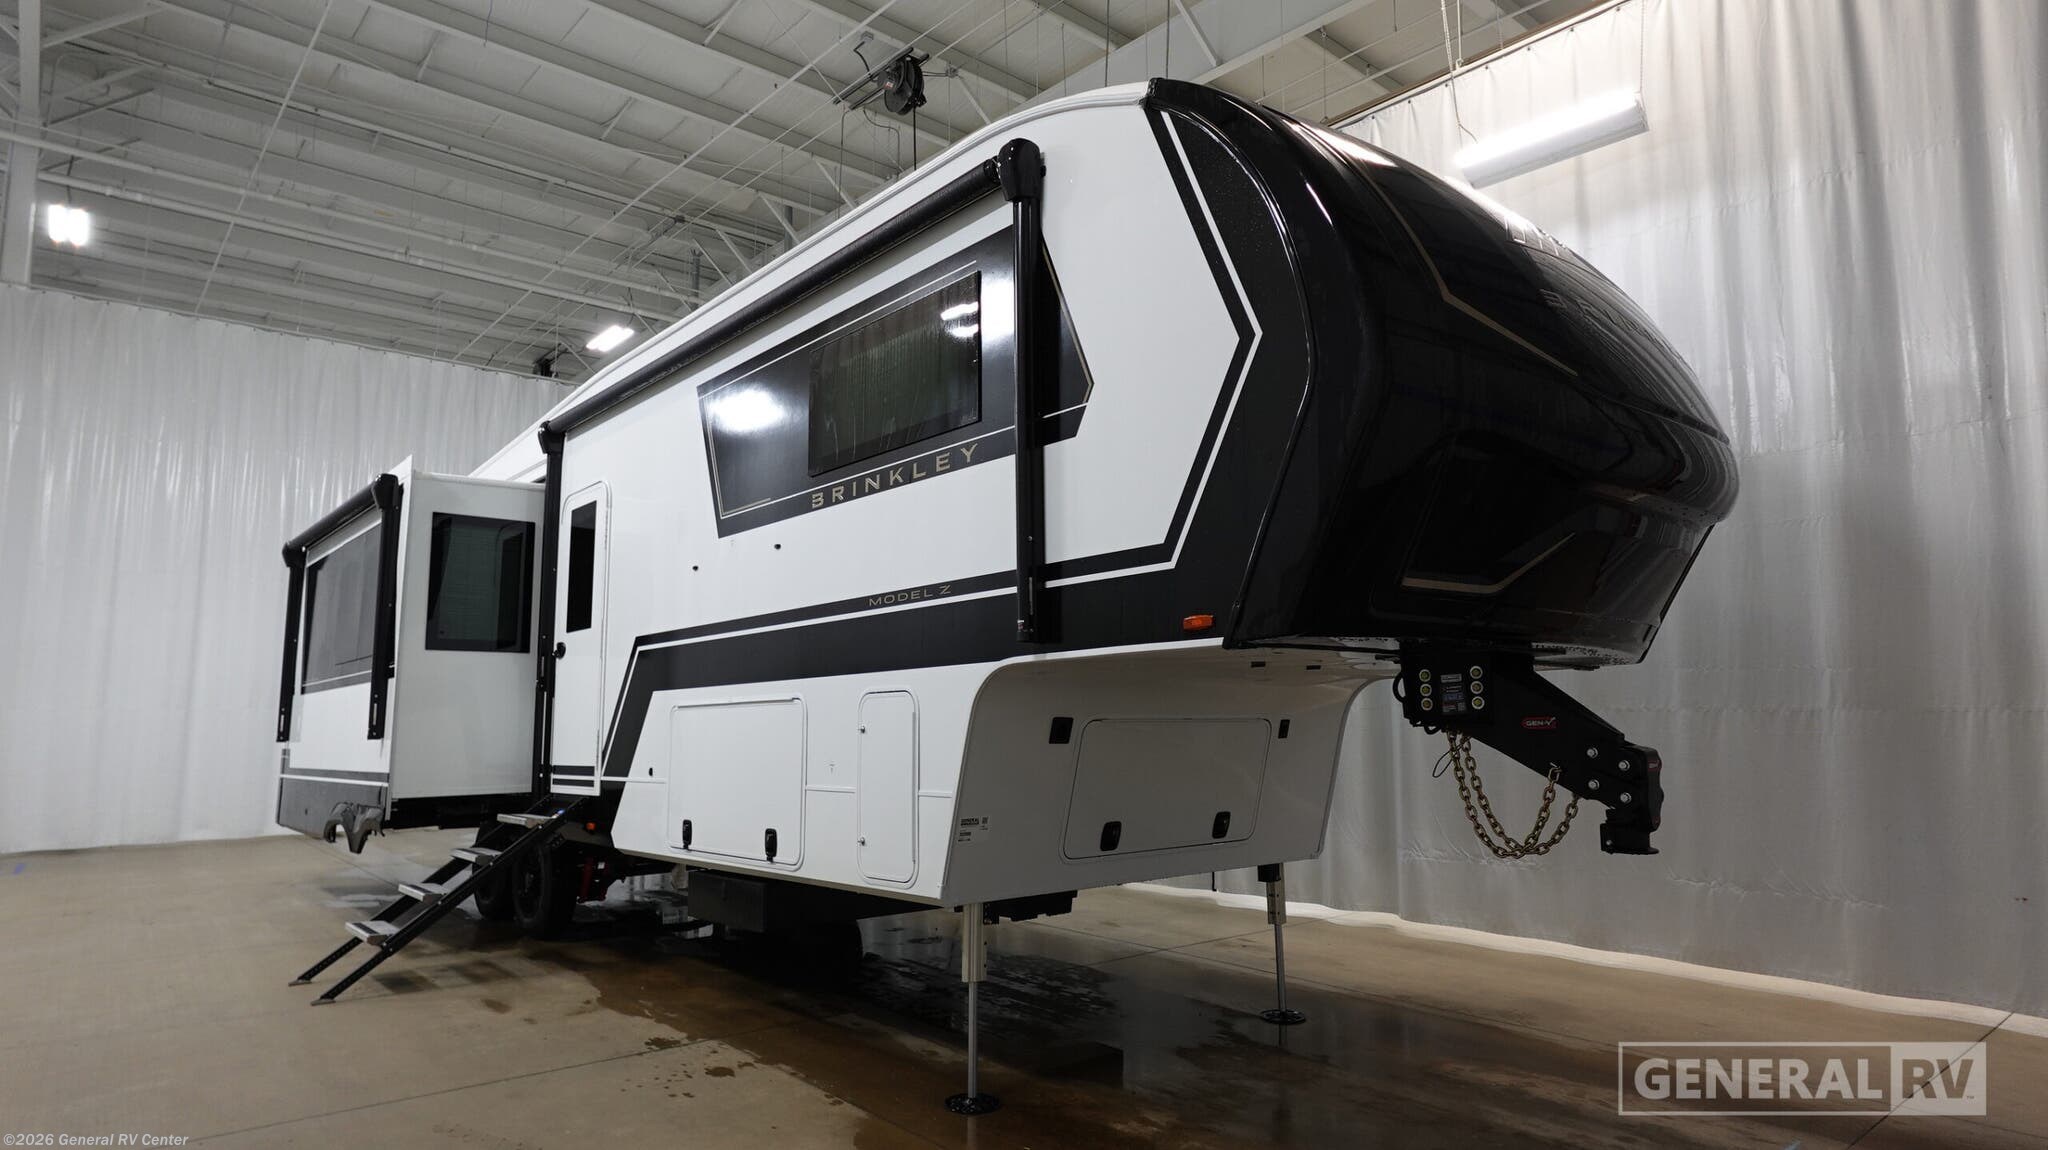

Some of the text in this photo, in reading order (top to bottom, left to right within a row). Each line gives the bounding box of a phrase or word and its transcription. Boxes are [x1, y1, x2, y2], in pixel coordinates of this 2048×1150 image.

[811, 443, 978, 509] BRINKLEY
[868, 584, 951, 607] MODEL Z
